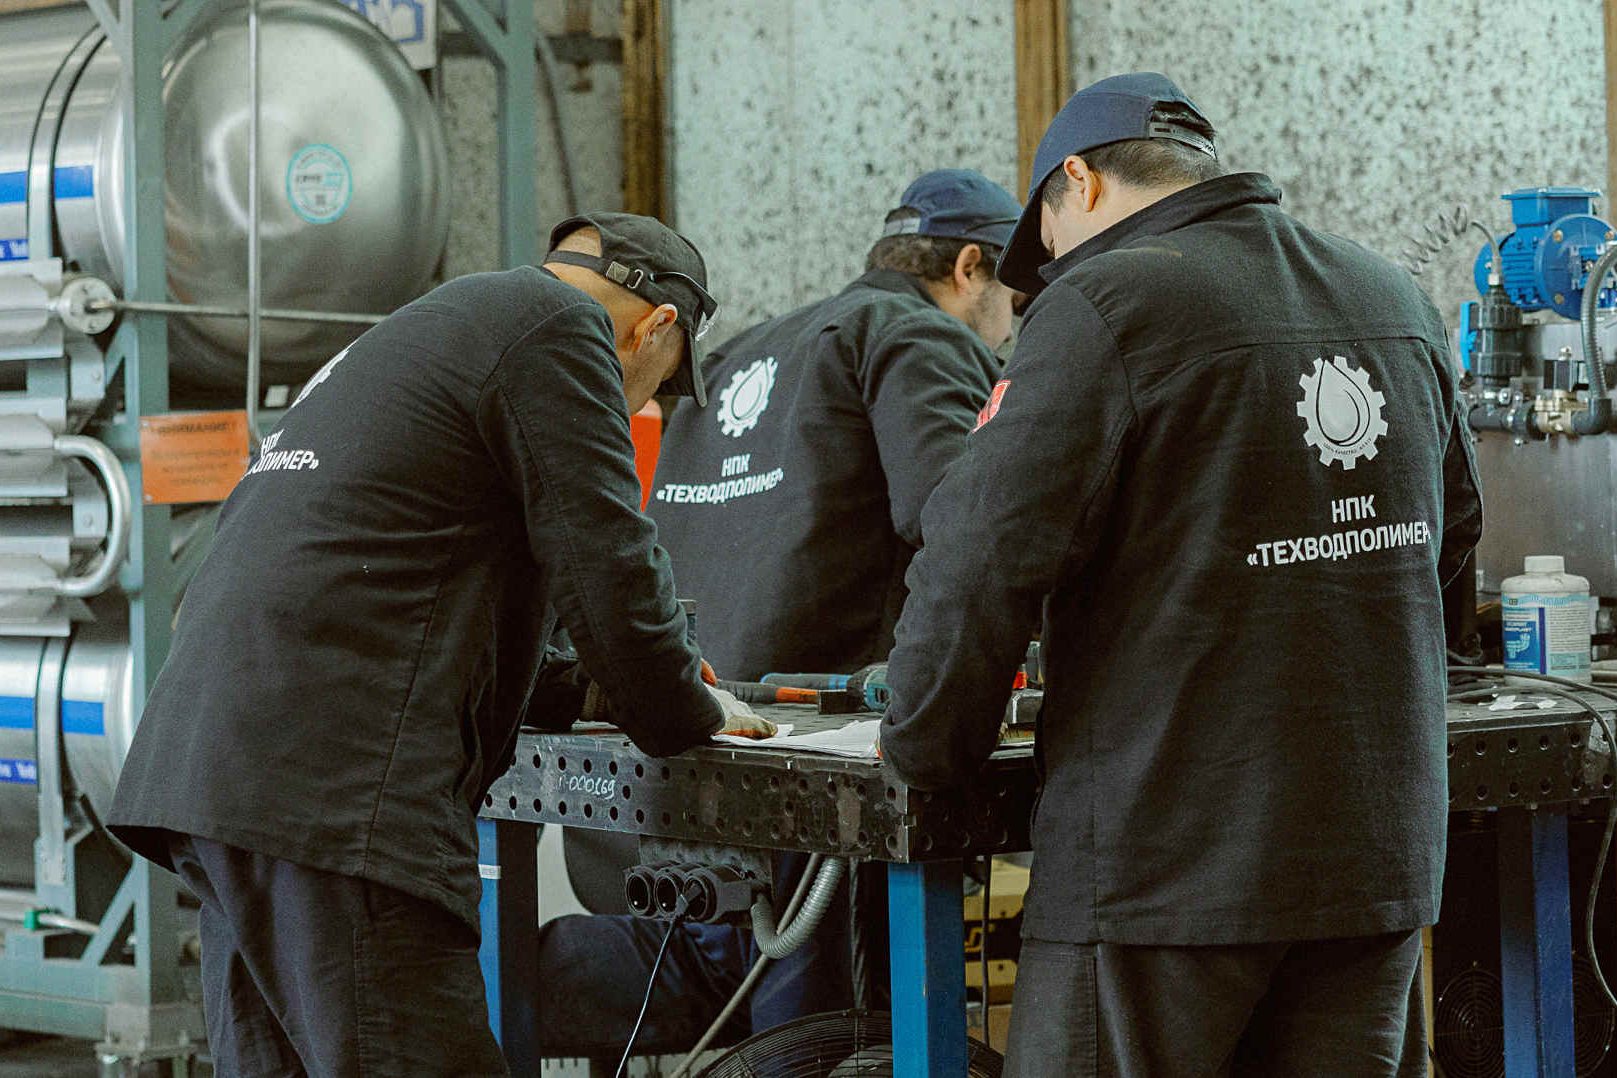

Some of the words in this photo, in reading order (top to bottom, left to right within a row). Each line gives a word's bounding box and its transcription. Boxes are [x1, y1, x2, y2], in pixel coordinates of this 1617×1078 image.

[260, 428, 285, 457] НП
[721, 453, 751, 478] НПК
[1331, 494, 1377, 524] НПК
[1246, 521, 1432, 567] «ТЕХВОДПОЛИМЕР
